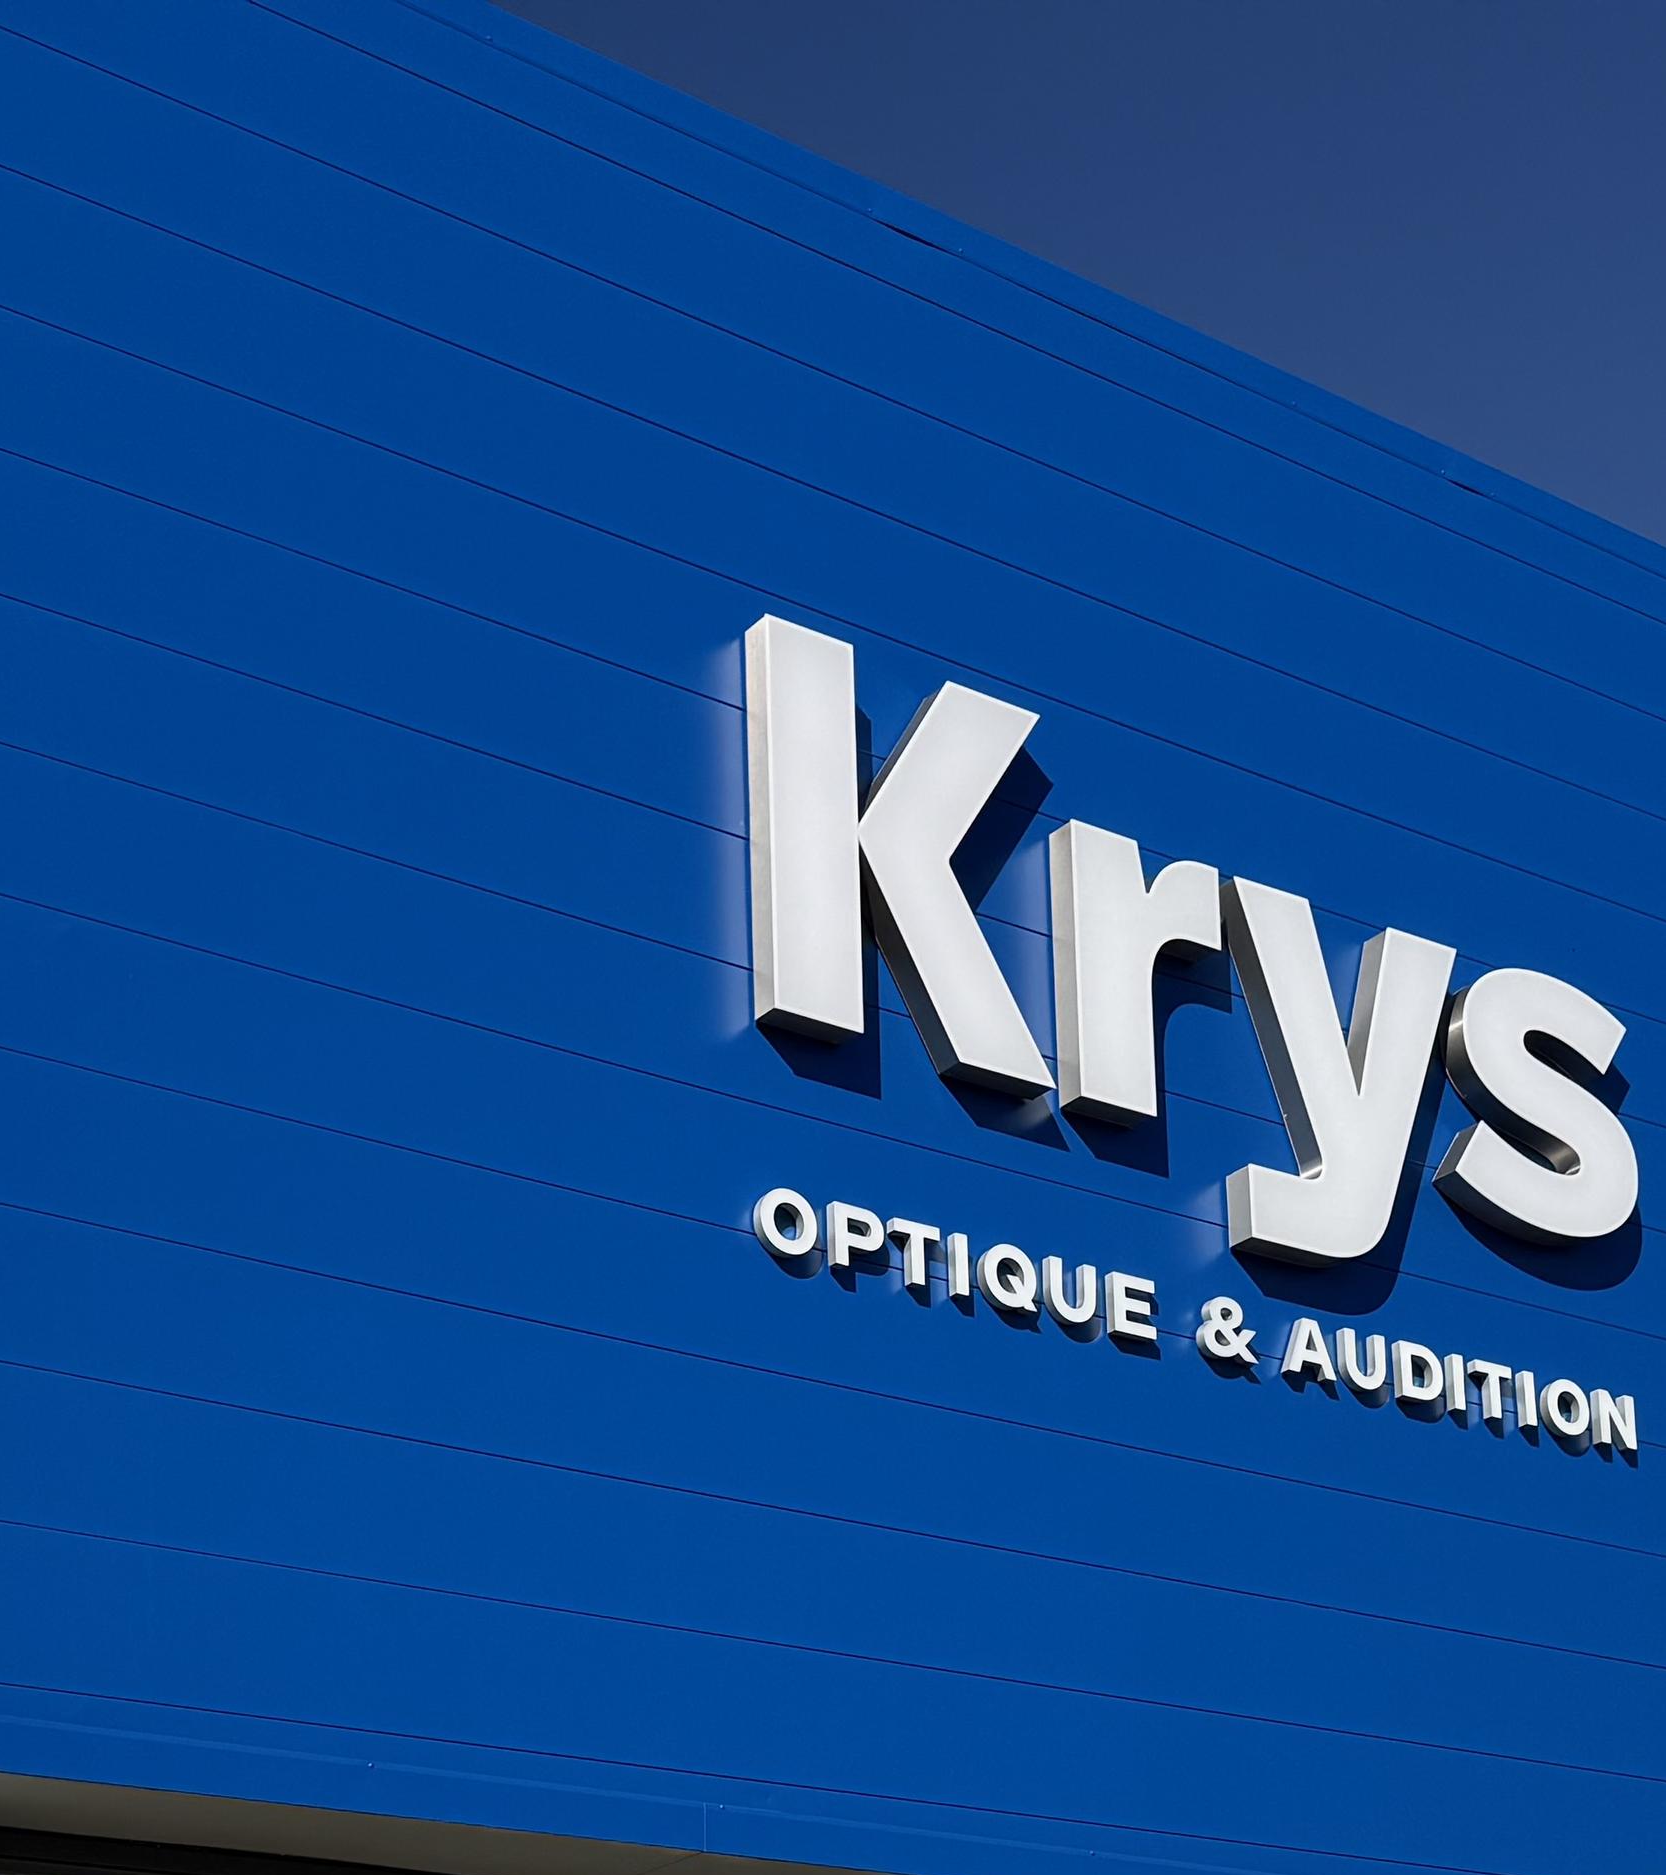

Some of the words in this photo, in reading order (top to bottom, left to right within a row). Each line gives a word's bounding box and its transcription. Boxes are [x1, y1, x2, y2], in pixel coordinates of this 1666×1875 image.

[746, 613, 1639, 1262] Krys
[753, 1187, 1157, 1341] OPTIQUE
[1197, 1296, 1257, 1365] &
[1281, 1318, 1639, 1451] AUDITION
